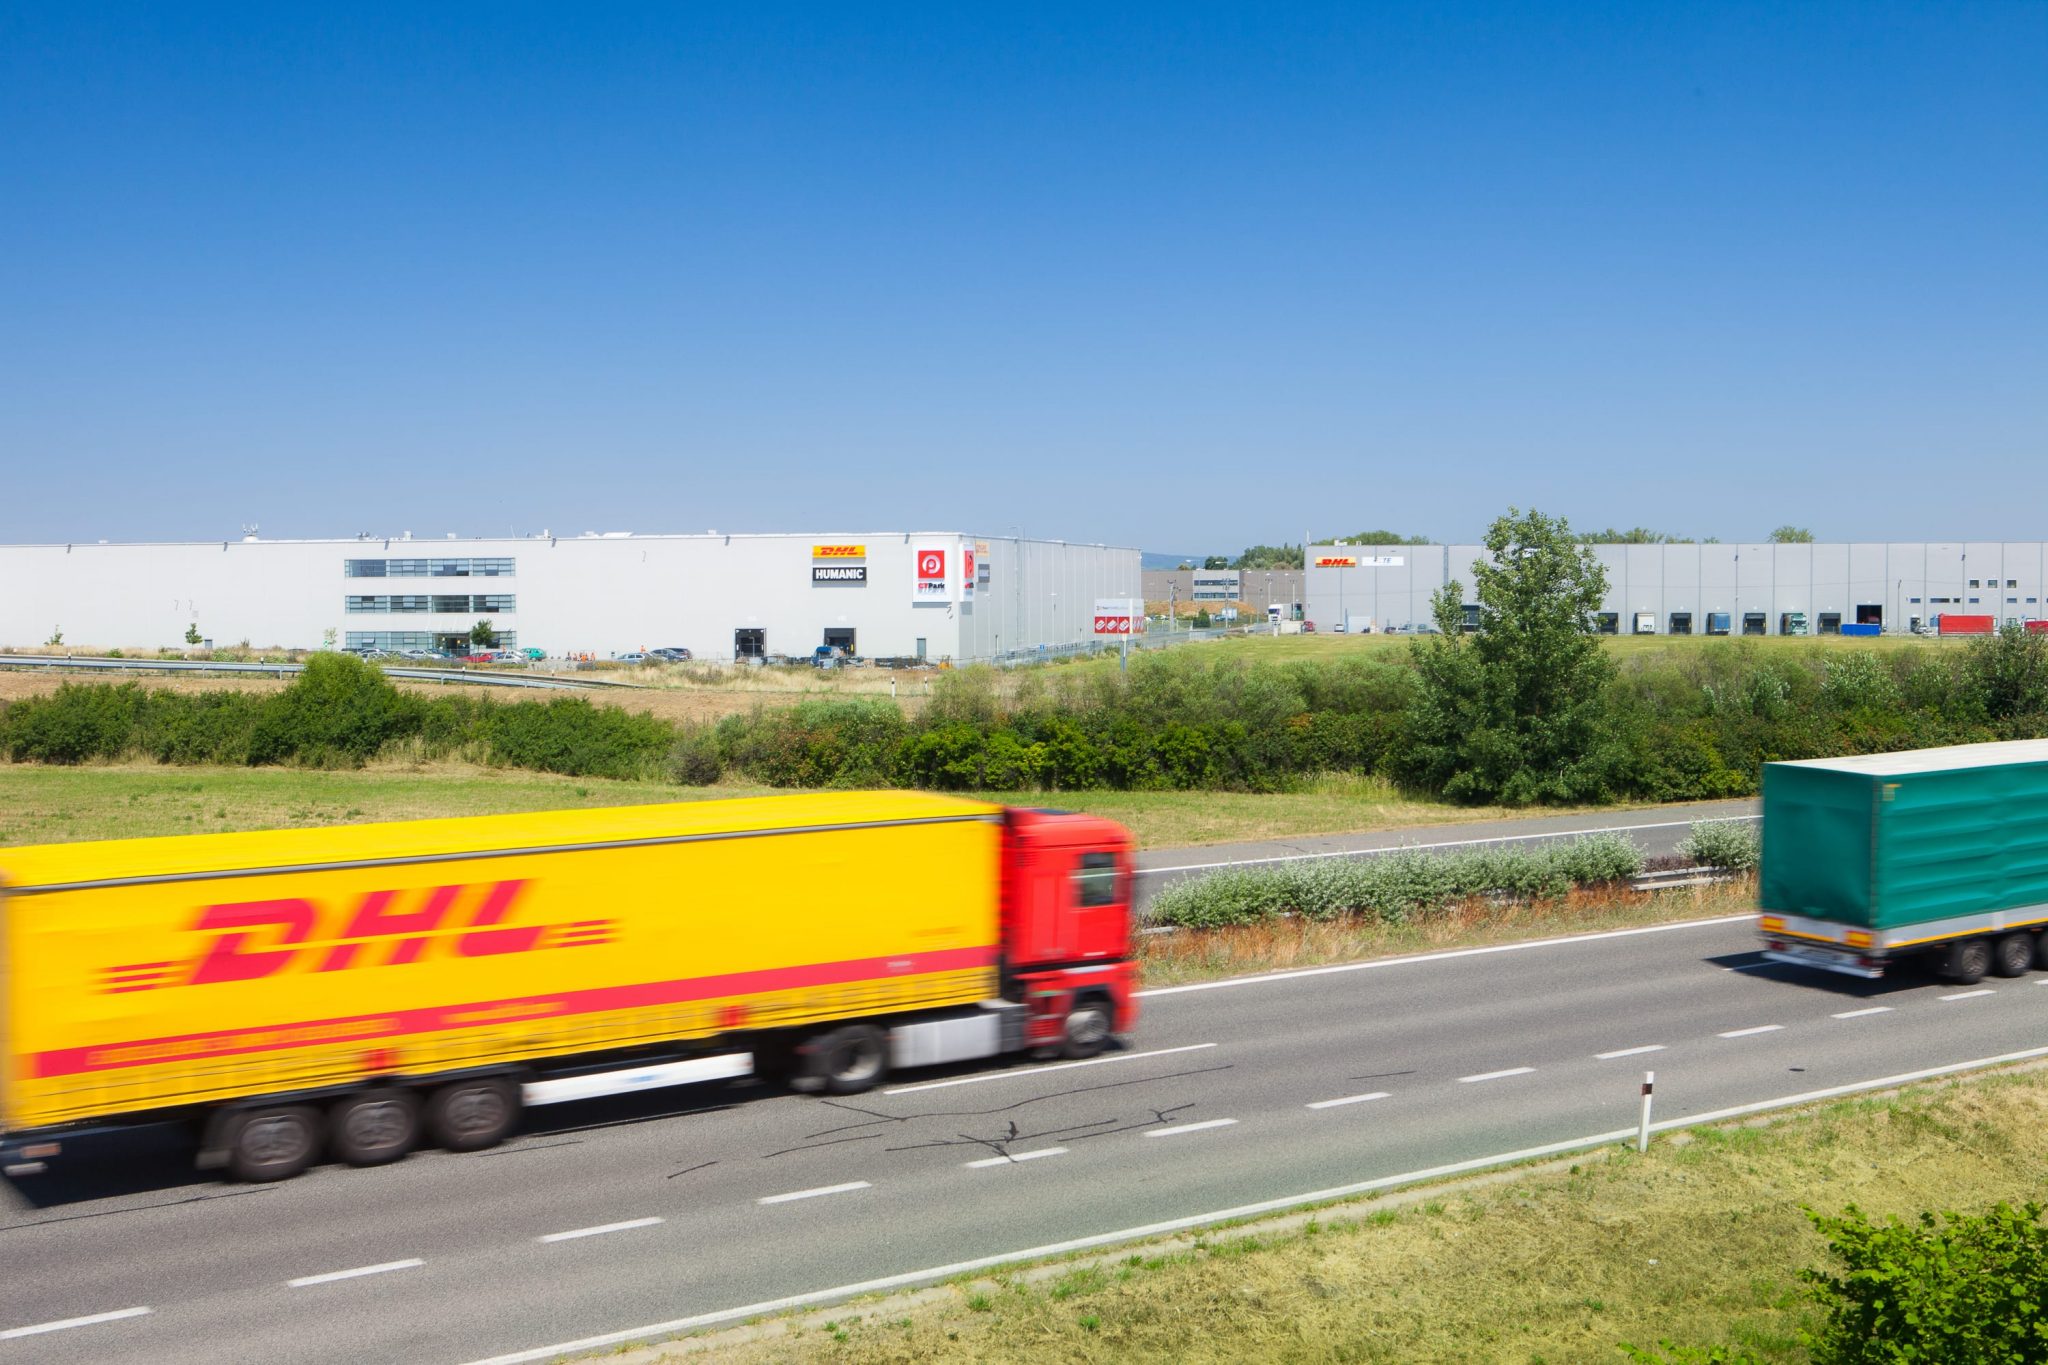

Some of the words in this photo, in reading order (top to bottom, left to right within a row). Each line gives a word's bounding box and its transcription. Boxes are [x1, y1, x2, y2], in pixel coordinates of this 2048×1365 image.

[820, 546, 858, 556] DHL
[1321, 558, 1351, 566] DHL
[815, 568, 864, 580] HUMANIC
[181, 878, 549, 985] DHL
